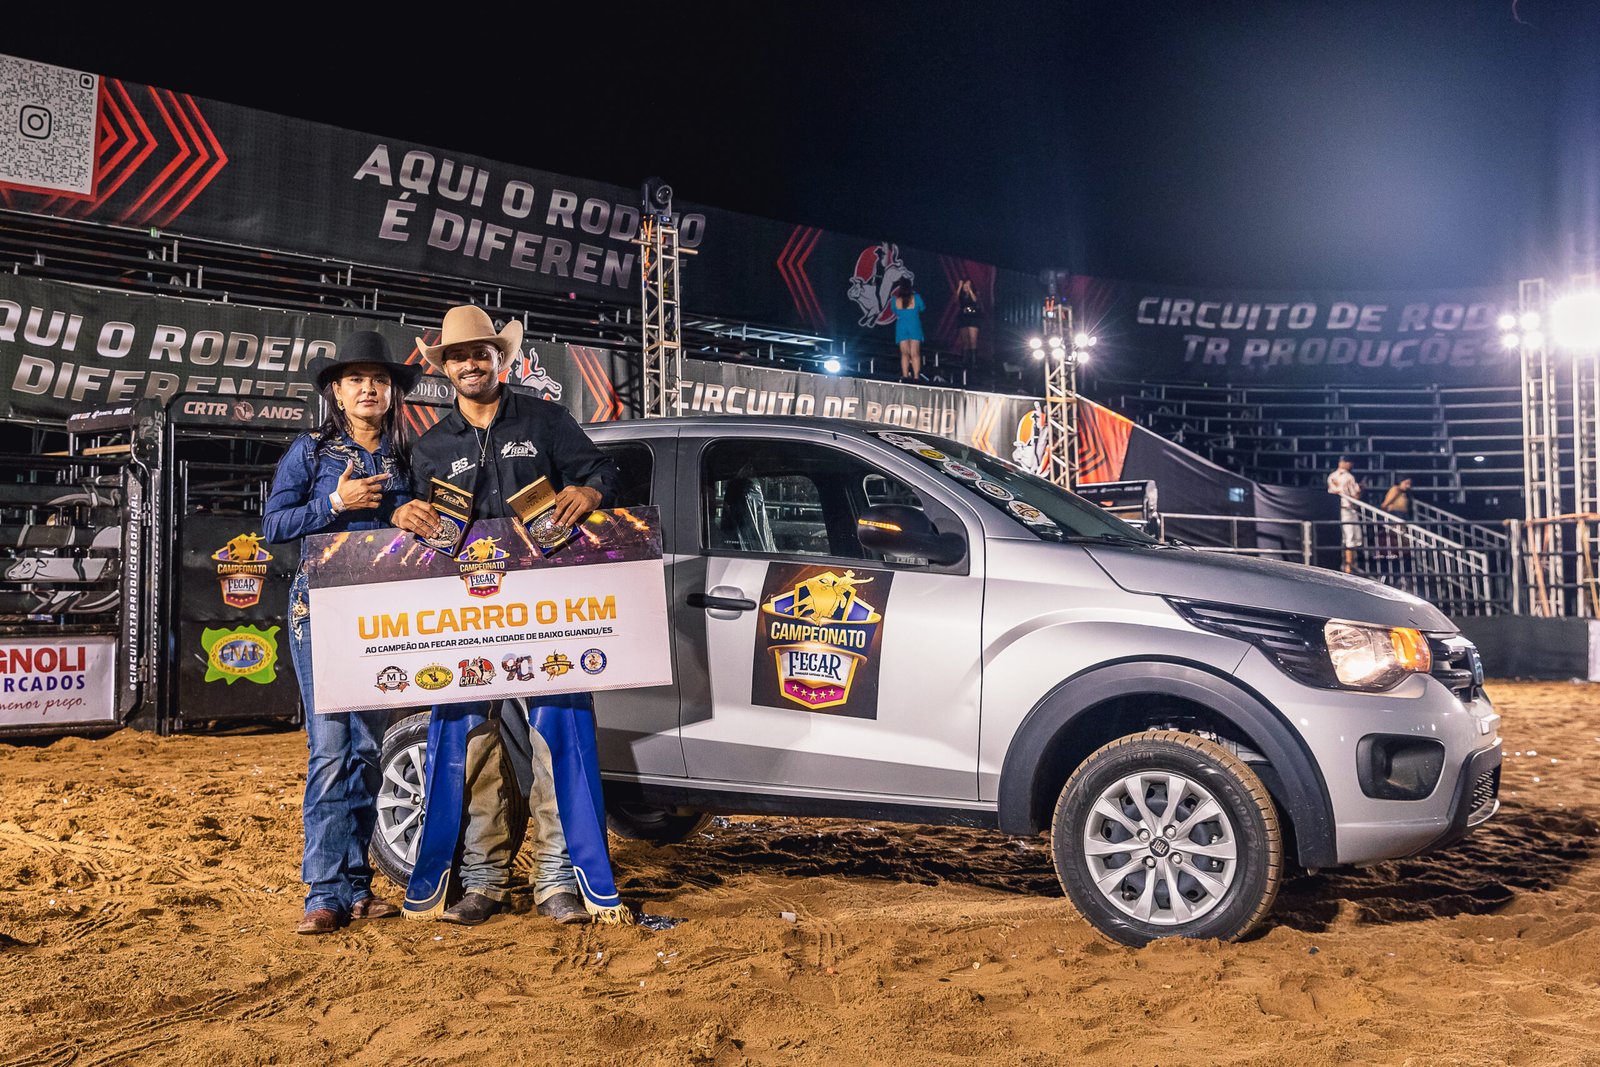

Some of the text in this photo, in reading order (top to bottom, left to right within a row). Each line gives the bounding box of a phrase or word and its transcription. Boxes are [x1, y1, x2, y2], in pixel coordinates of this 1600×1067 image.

[353, 144, 490, 208] AQUI
[500, 180, 535, 219] O
[378, 191, 417, 242] É
[1137, 296, 1318, 330] CIRCUITO
[1327, 302, 1388, 332] DE
[97, 321, 136, 358] O
[149, 324, 338, 373] RODEIO
[1182, 334, 1229, 365] TR
[184, 401, 304, 421] CRTR ANOS
[672, 380, 957, 435] CIRCUITO DE RODEIO
[451, 457, 469, 473] BS
[217, 563, 267, 574] CAMPEONATO
[460, 561, 505, 573] CAMPEONATO
[470, 573, 497, 587] FECAR
[227, 578, 256, 593] FECAR
[358, 612, 410, 640] UM
[416, 603, 529, 635] CARRO
[564, 595, 617, 623] KM
[365, 626, 613, 654] AO CAMPEÃO DA FECAR 2024, NA CIDADE DE BAIXO GUANDU/ES
[770, 621, 866, 649] CAMPEONATO
[788, 651, 842, 681] FECAR
[42, 697, 87, 716] preço.
